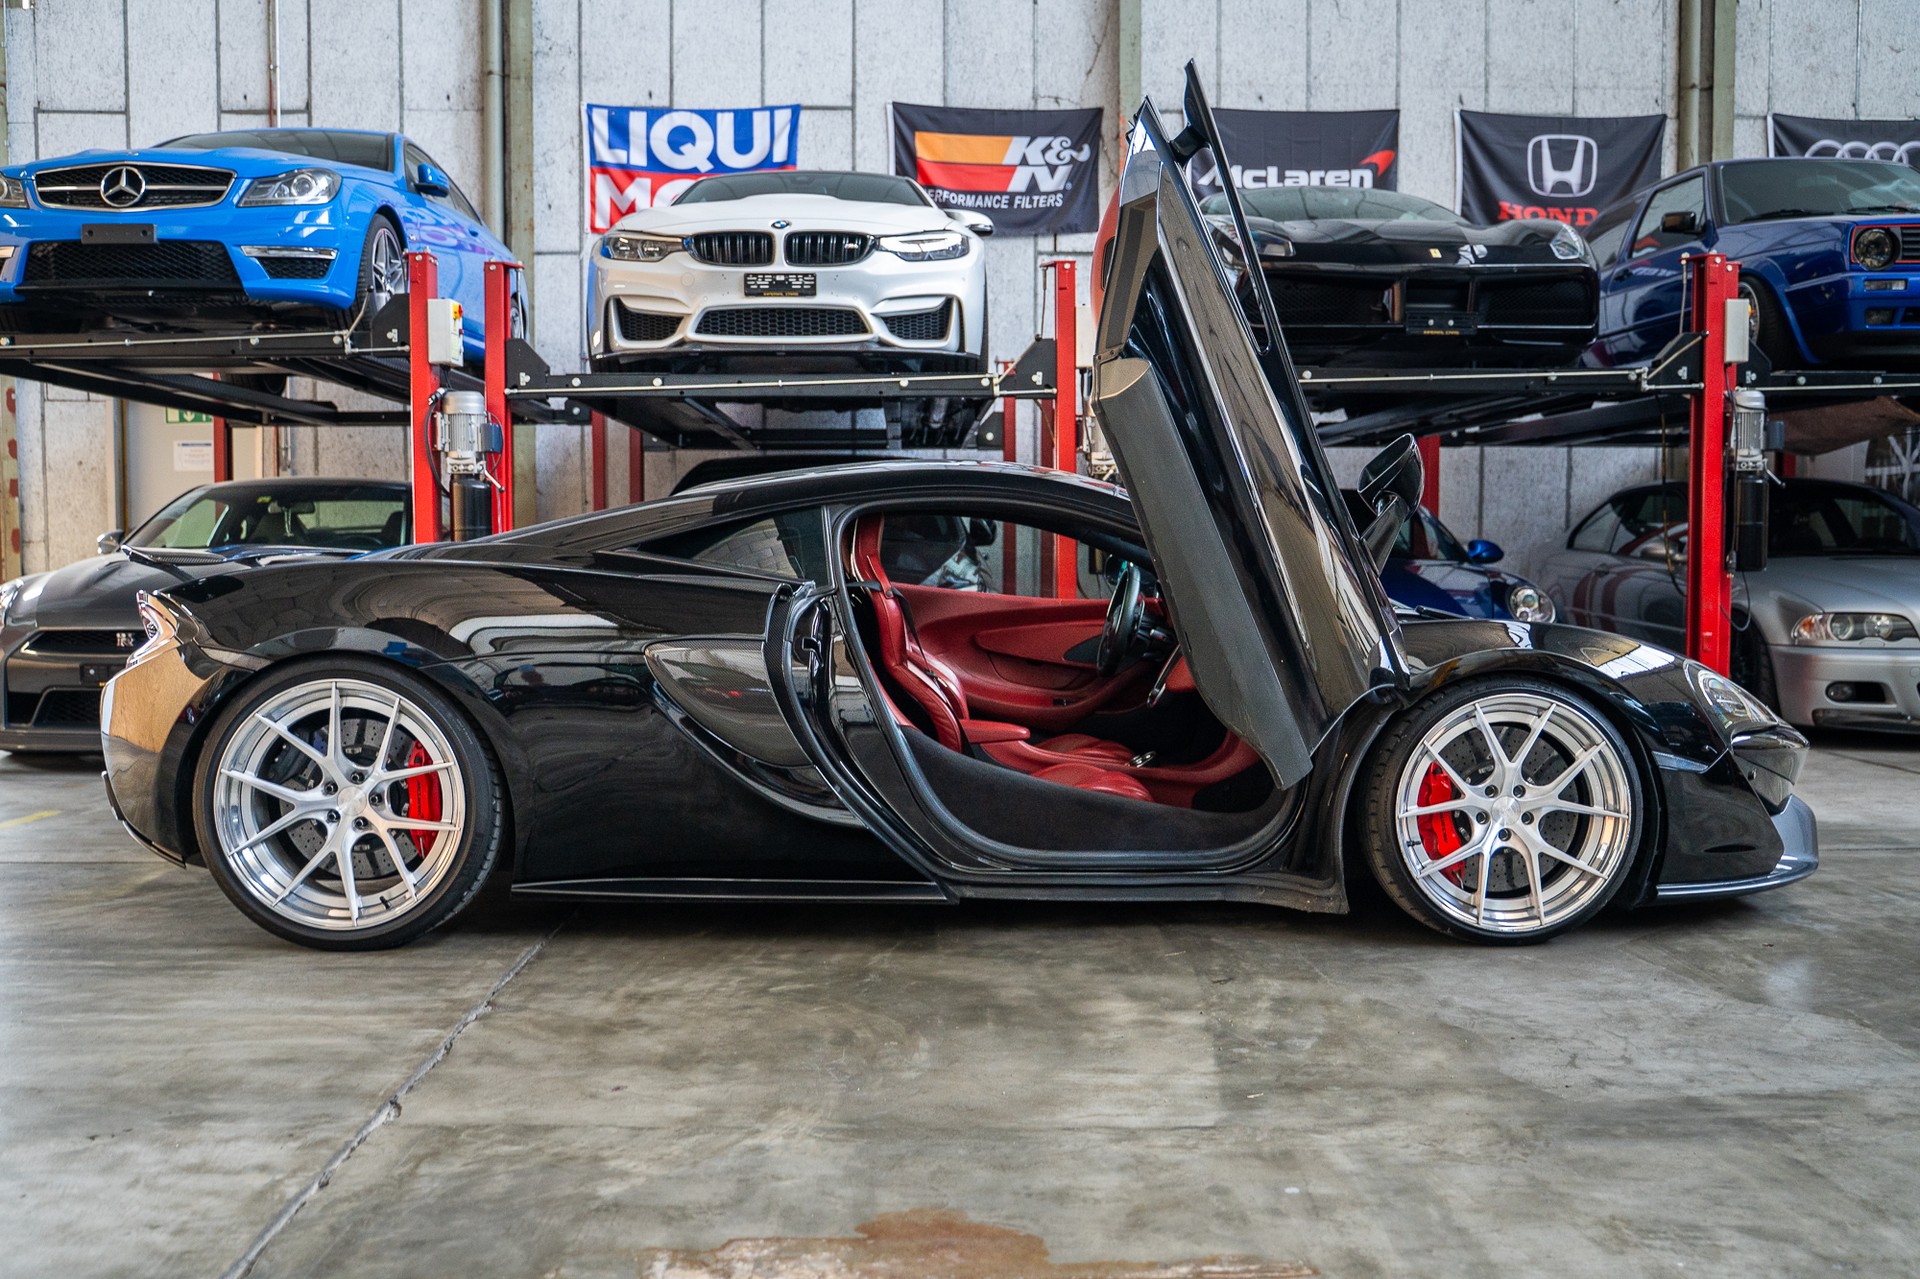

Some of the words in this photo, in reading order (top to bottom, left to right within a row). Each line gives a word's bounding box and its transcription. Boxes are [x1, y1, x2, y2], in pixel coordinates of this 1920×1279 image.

[592, 108, 792, 173] LIQUI
[1197, 164, 1374, 189] McLaren
[924, 188, 1009, 208] ERFORMANCE
[1014, 192, 1063, 208] FILTERS
[1498, 201, 1598, 226] HOND
